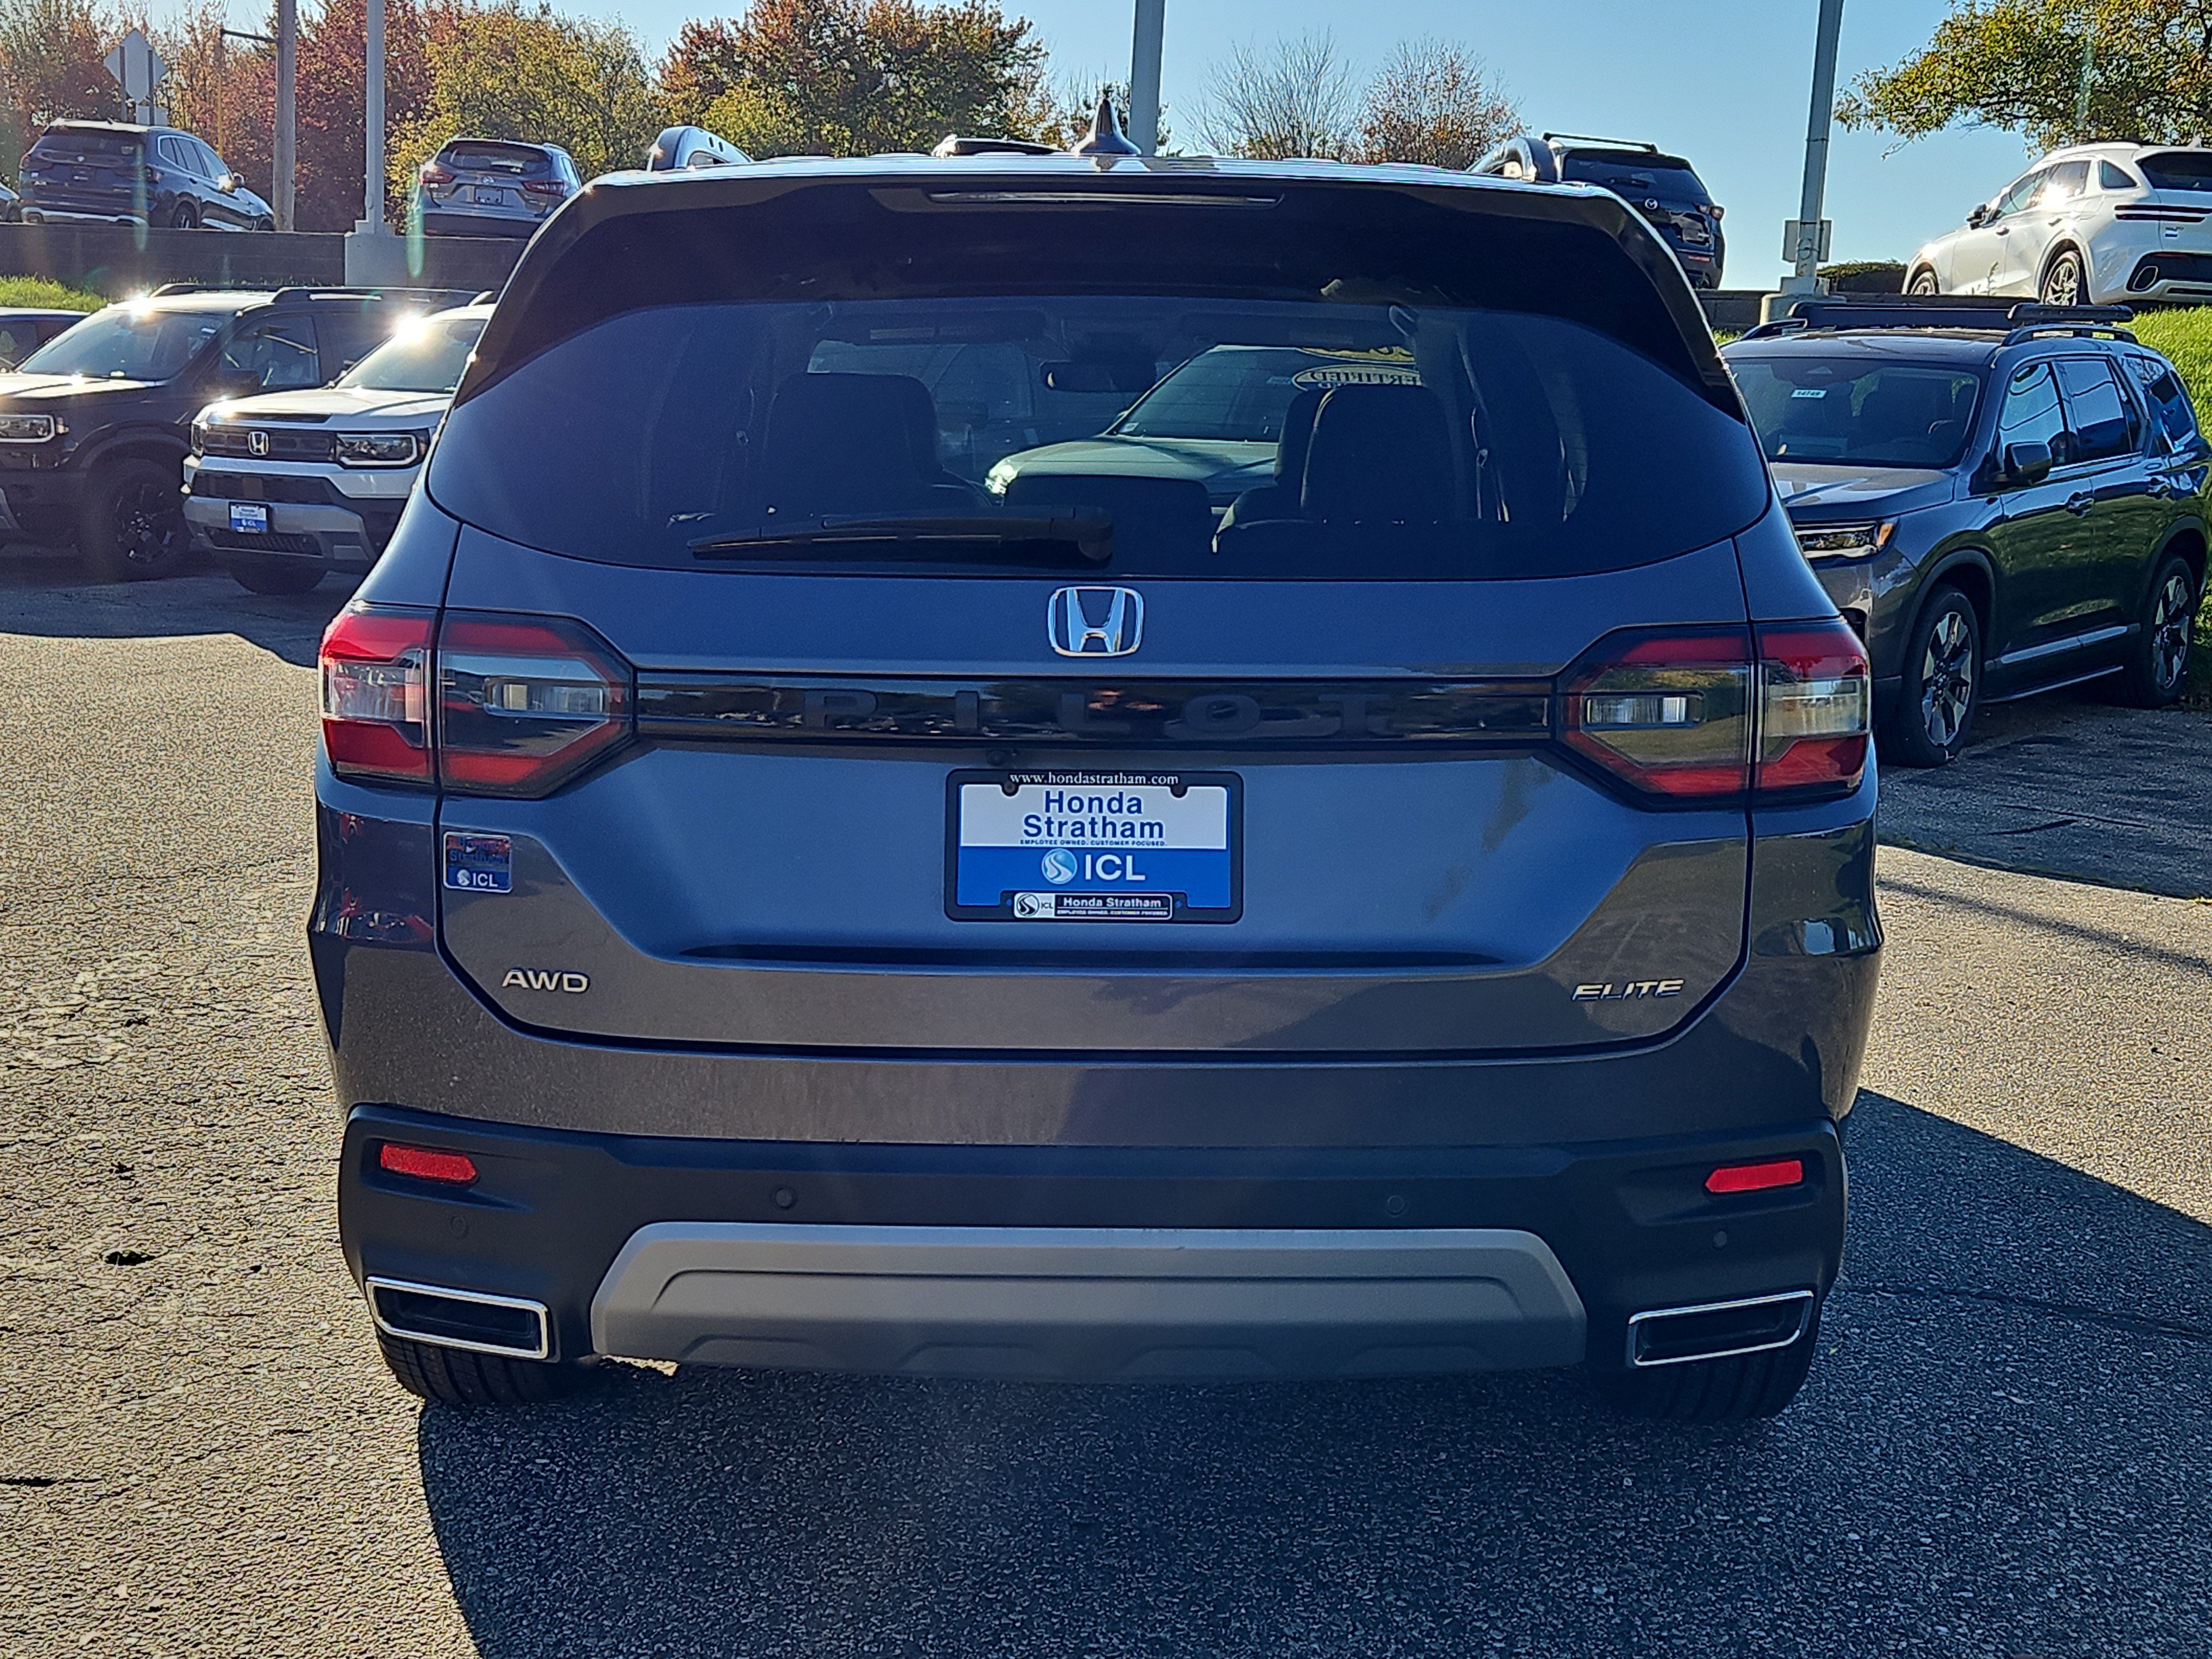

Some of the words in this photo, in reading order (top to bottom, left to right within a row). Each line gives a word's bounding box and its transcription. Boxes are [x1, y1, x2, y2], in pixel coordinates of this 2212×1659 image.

[803, 688, 1392, 738] PILOT
[1009, 772, 1179, 785] www.hondastratham.com
[1044, 790, 1143, 814] Honda
[1023, 814, 1165, 839] Stratham
[472, 872, 498, 887] ICL
[1084, 854, 1146, 881] ICL
[1063, 897, 1103, 907] Honda
[1106, 898, 1161, 908] Stratham
[502, 969, 588, 993] AWD
[1572, 979, 1684, 1001] ELITE
